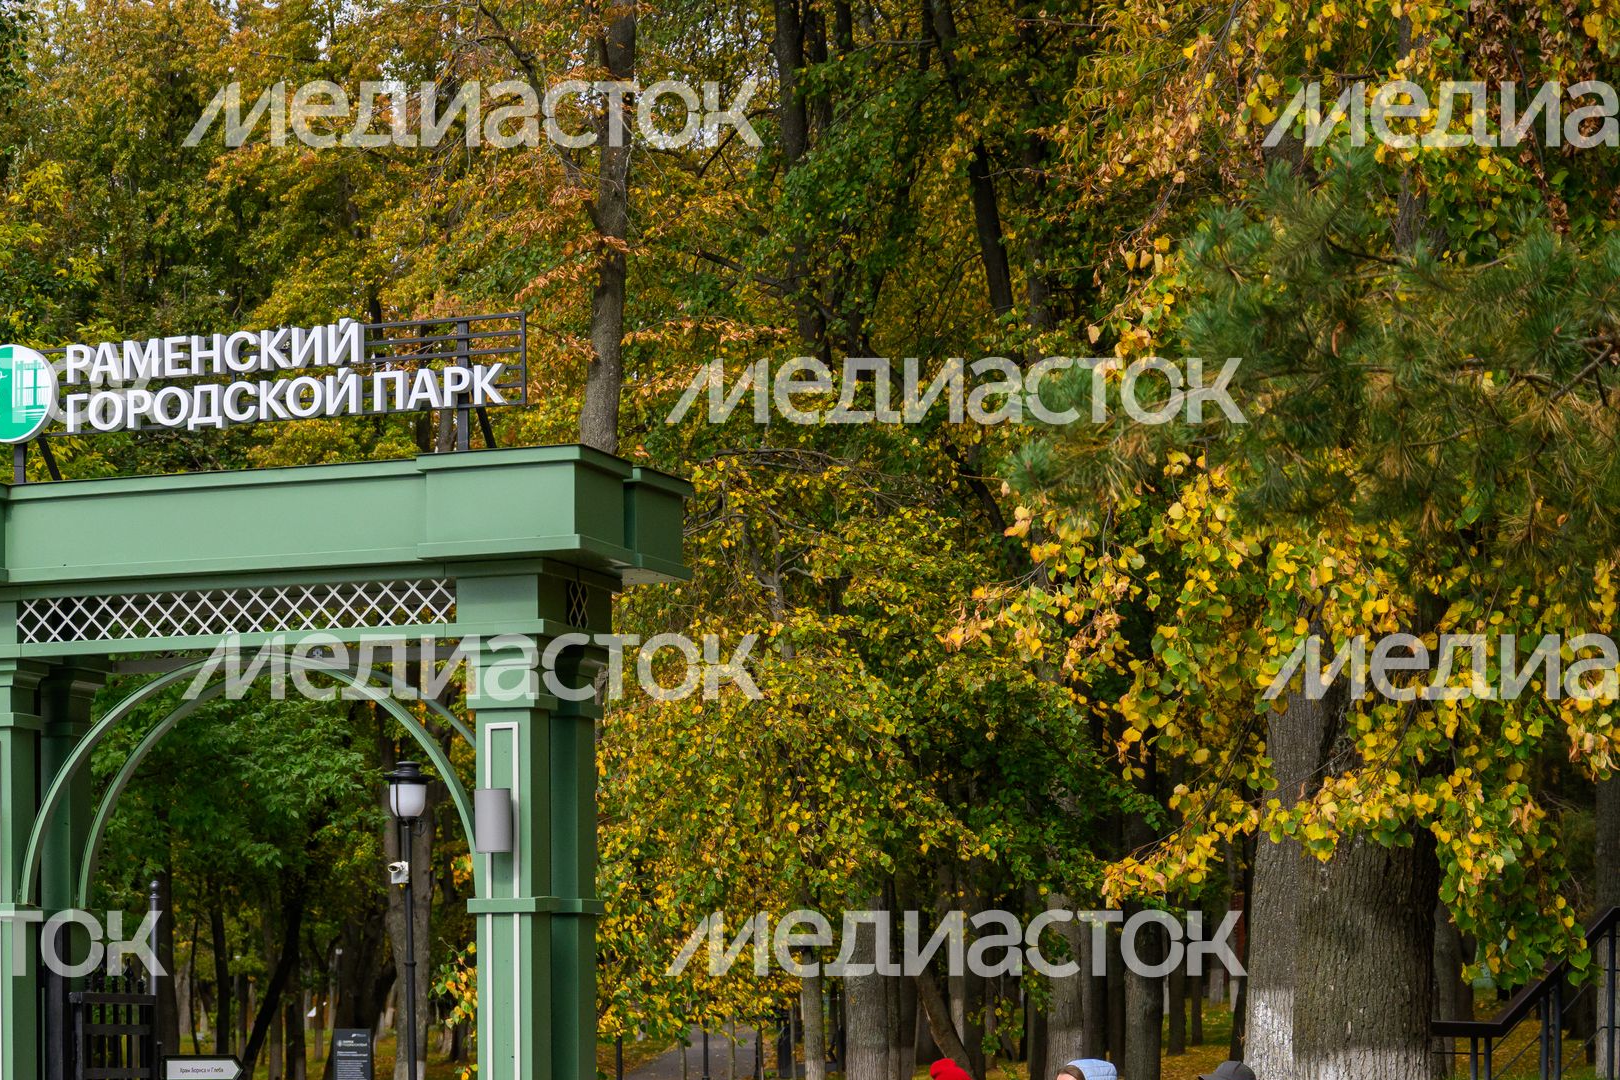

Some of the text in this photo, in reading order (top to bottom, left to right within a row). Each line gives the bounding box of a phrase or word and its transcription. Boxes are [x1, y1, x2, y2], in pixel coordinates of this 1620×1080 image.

[65, 318, 365, 385] РАМЕНСКИЙ
[66, 363, 507, 433] ГОРОДСКОЙ ПАРК
